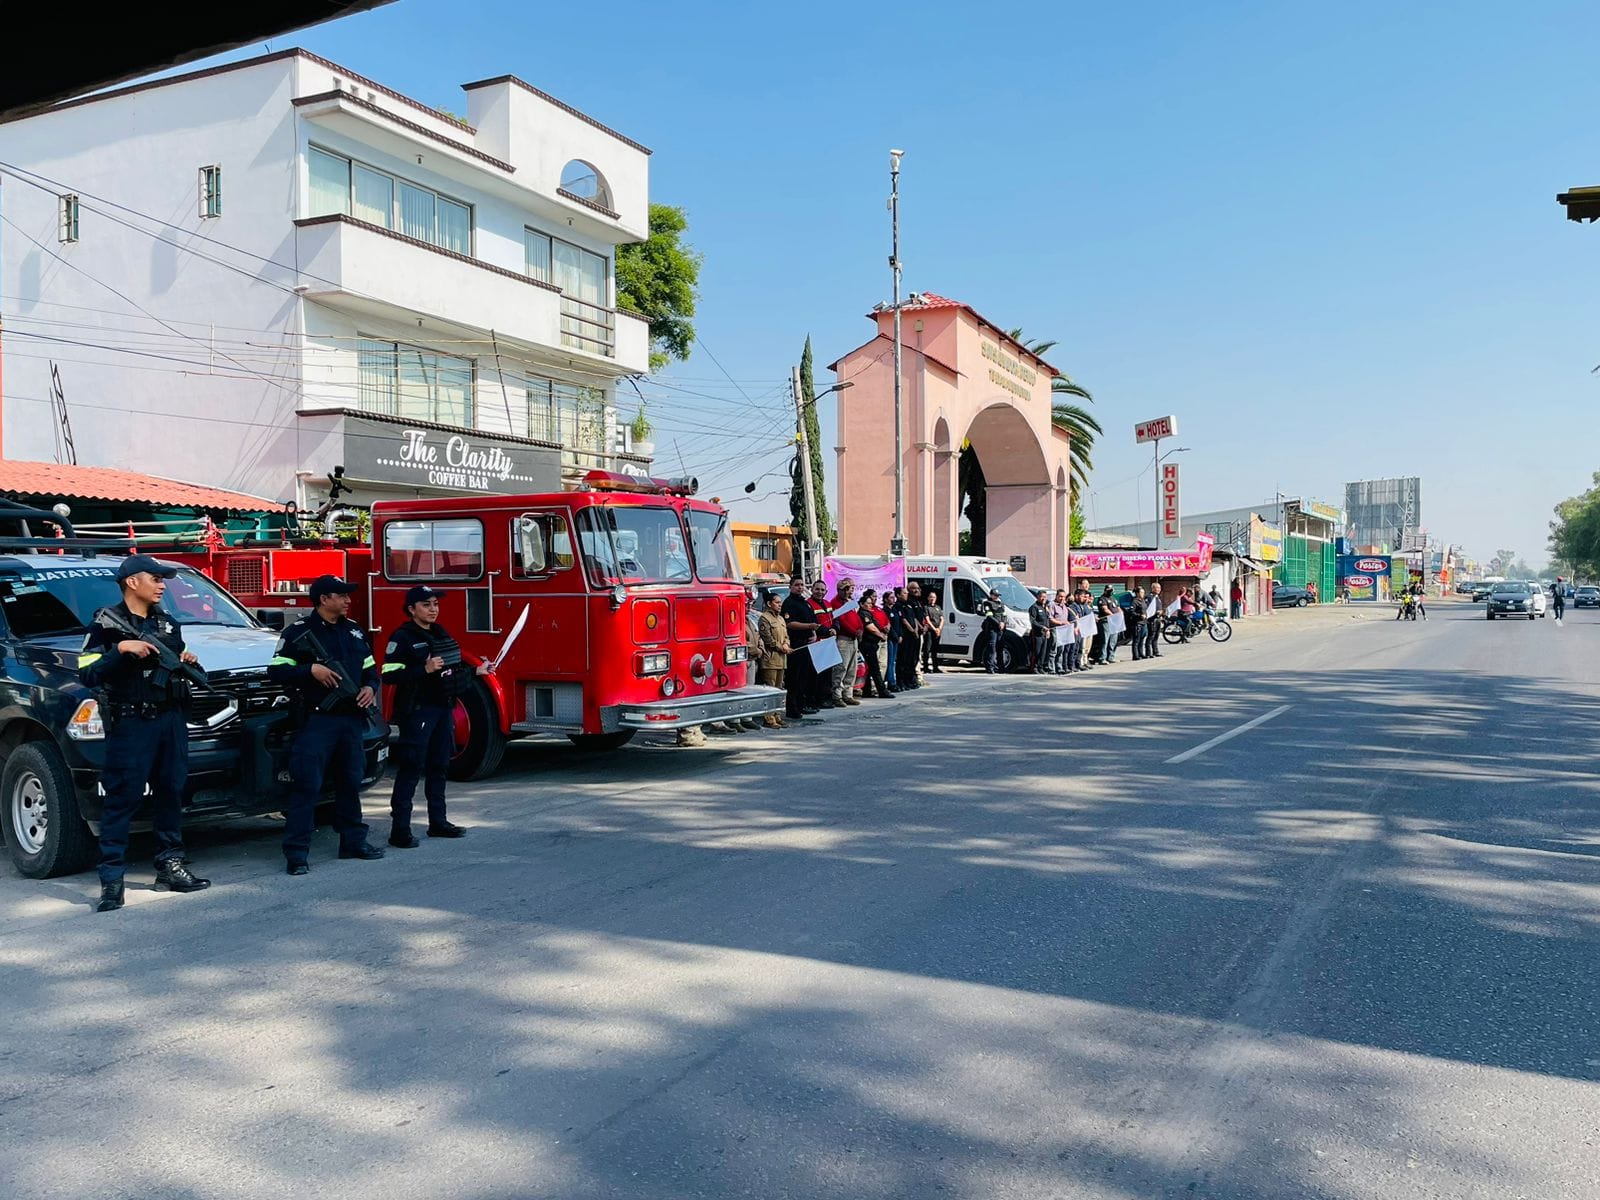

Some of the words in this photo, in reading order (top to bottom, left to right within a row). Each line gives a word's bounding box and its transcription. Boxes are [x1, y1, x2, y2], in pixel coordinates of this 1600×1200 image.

[1146, 420, 1170, 438] HOTEL
[400, 430, 438, 462] The
[446, 436, 514, 481] Clarity
[429, 470, 467, 487] COFFEE
[469, 475, 489, 490] BAR
[1165, 466, 1176, 535] HOTEL
[906, 565, 938, 573] ULANCIA
